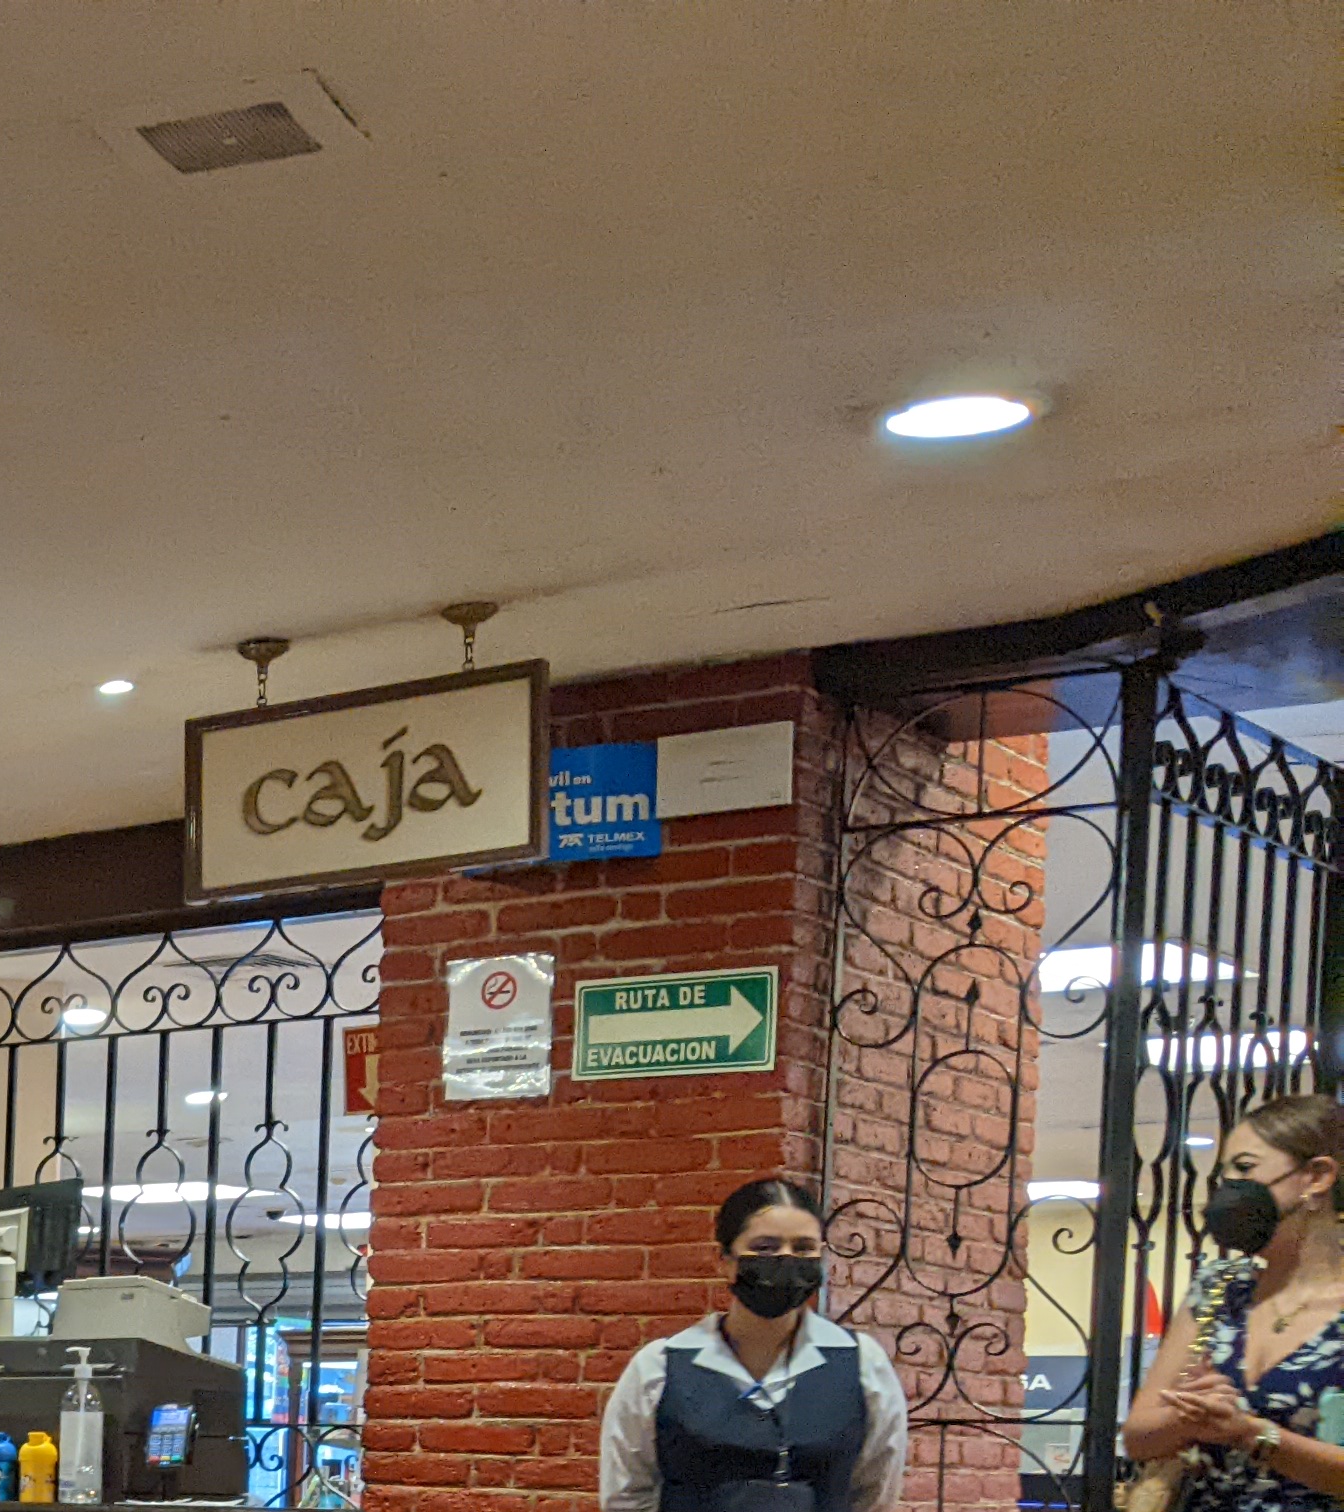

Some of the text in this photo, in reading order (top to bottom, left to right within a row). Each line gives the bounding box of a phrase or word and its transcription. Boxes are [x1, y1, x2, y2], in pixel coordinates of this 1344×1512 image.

[242, 725, 483, 842] caja
[587, 831, 646, 844] TELMEX
[614, 984, 707, 1011] RUTA DE
[585, 1040, 717, 1068] EVACUACION
